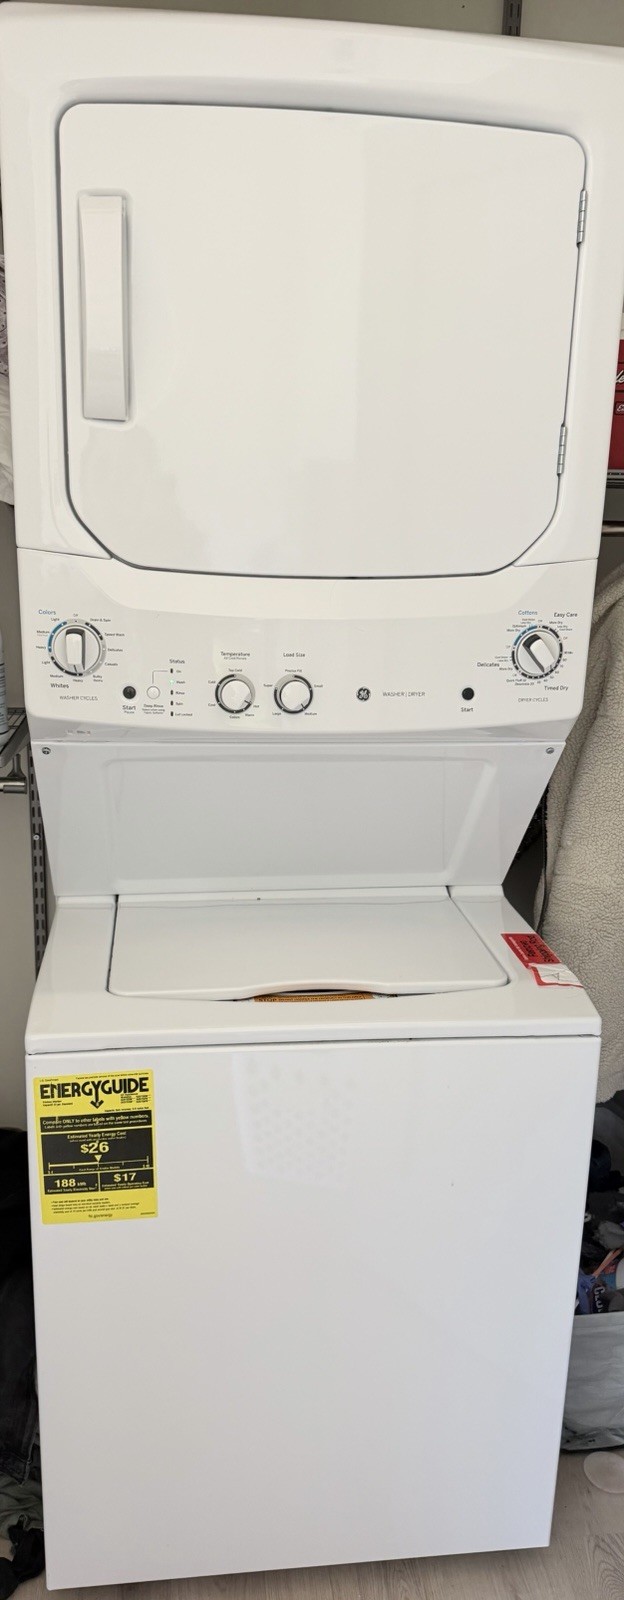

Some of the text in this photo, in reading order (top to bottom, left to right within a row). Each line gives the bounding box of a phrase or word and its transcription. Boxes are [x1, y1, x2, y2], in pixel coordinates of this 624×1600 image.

[40, 1077, 150, 1104] ENERGYGUIDE
[80, 1141, 109, 1154] $26
[113, 1172, 137, 1182] $17
[54, 1179, 76, 1188] 188
